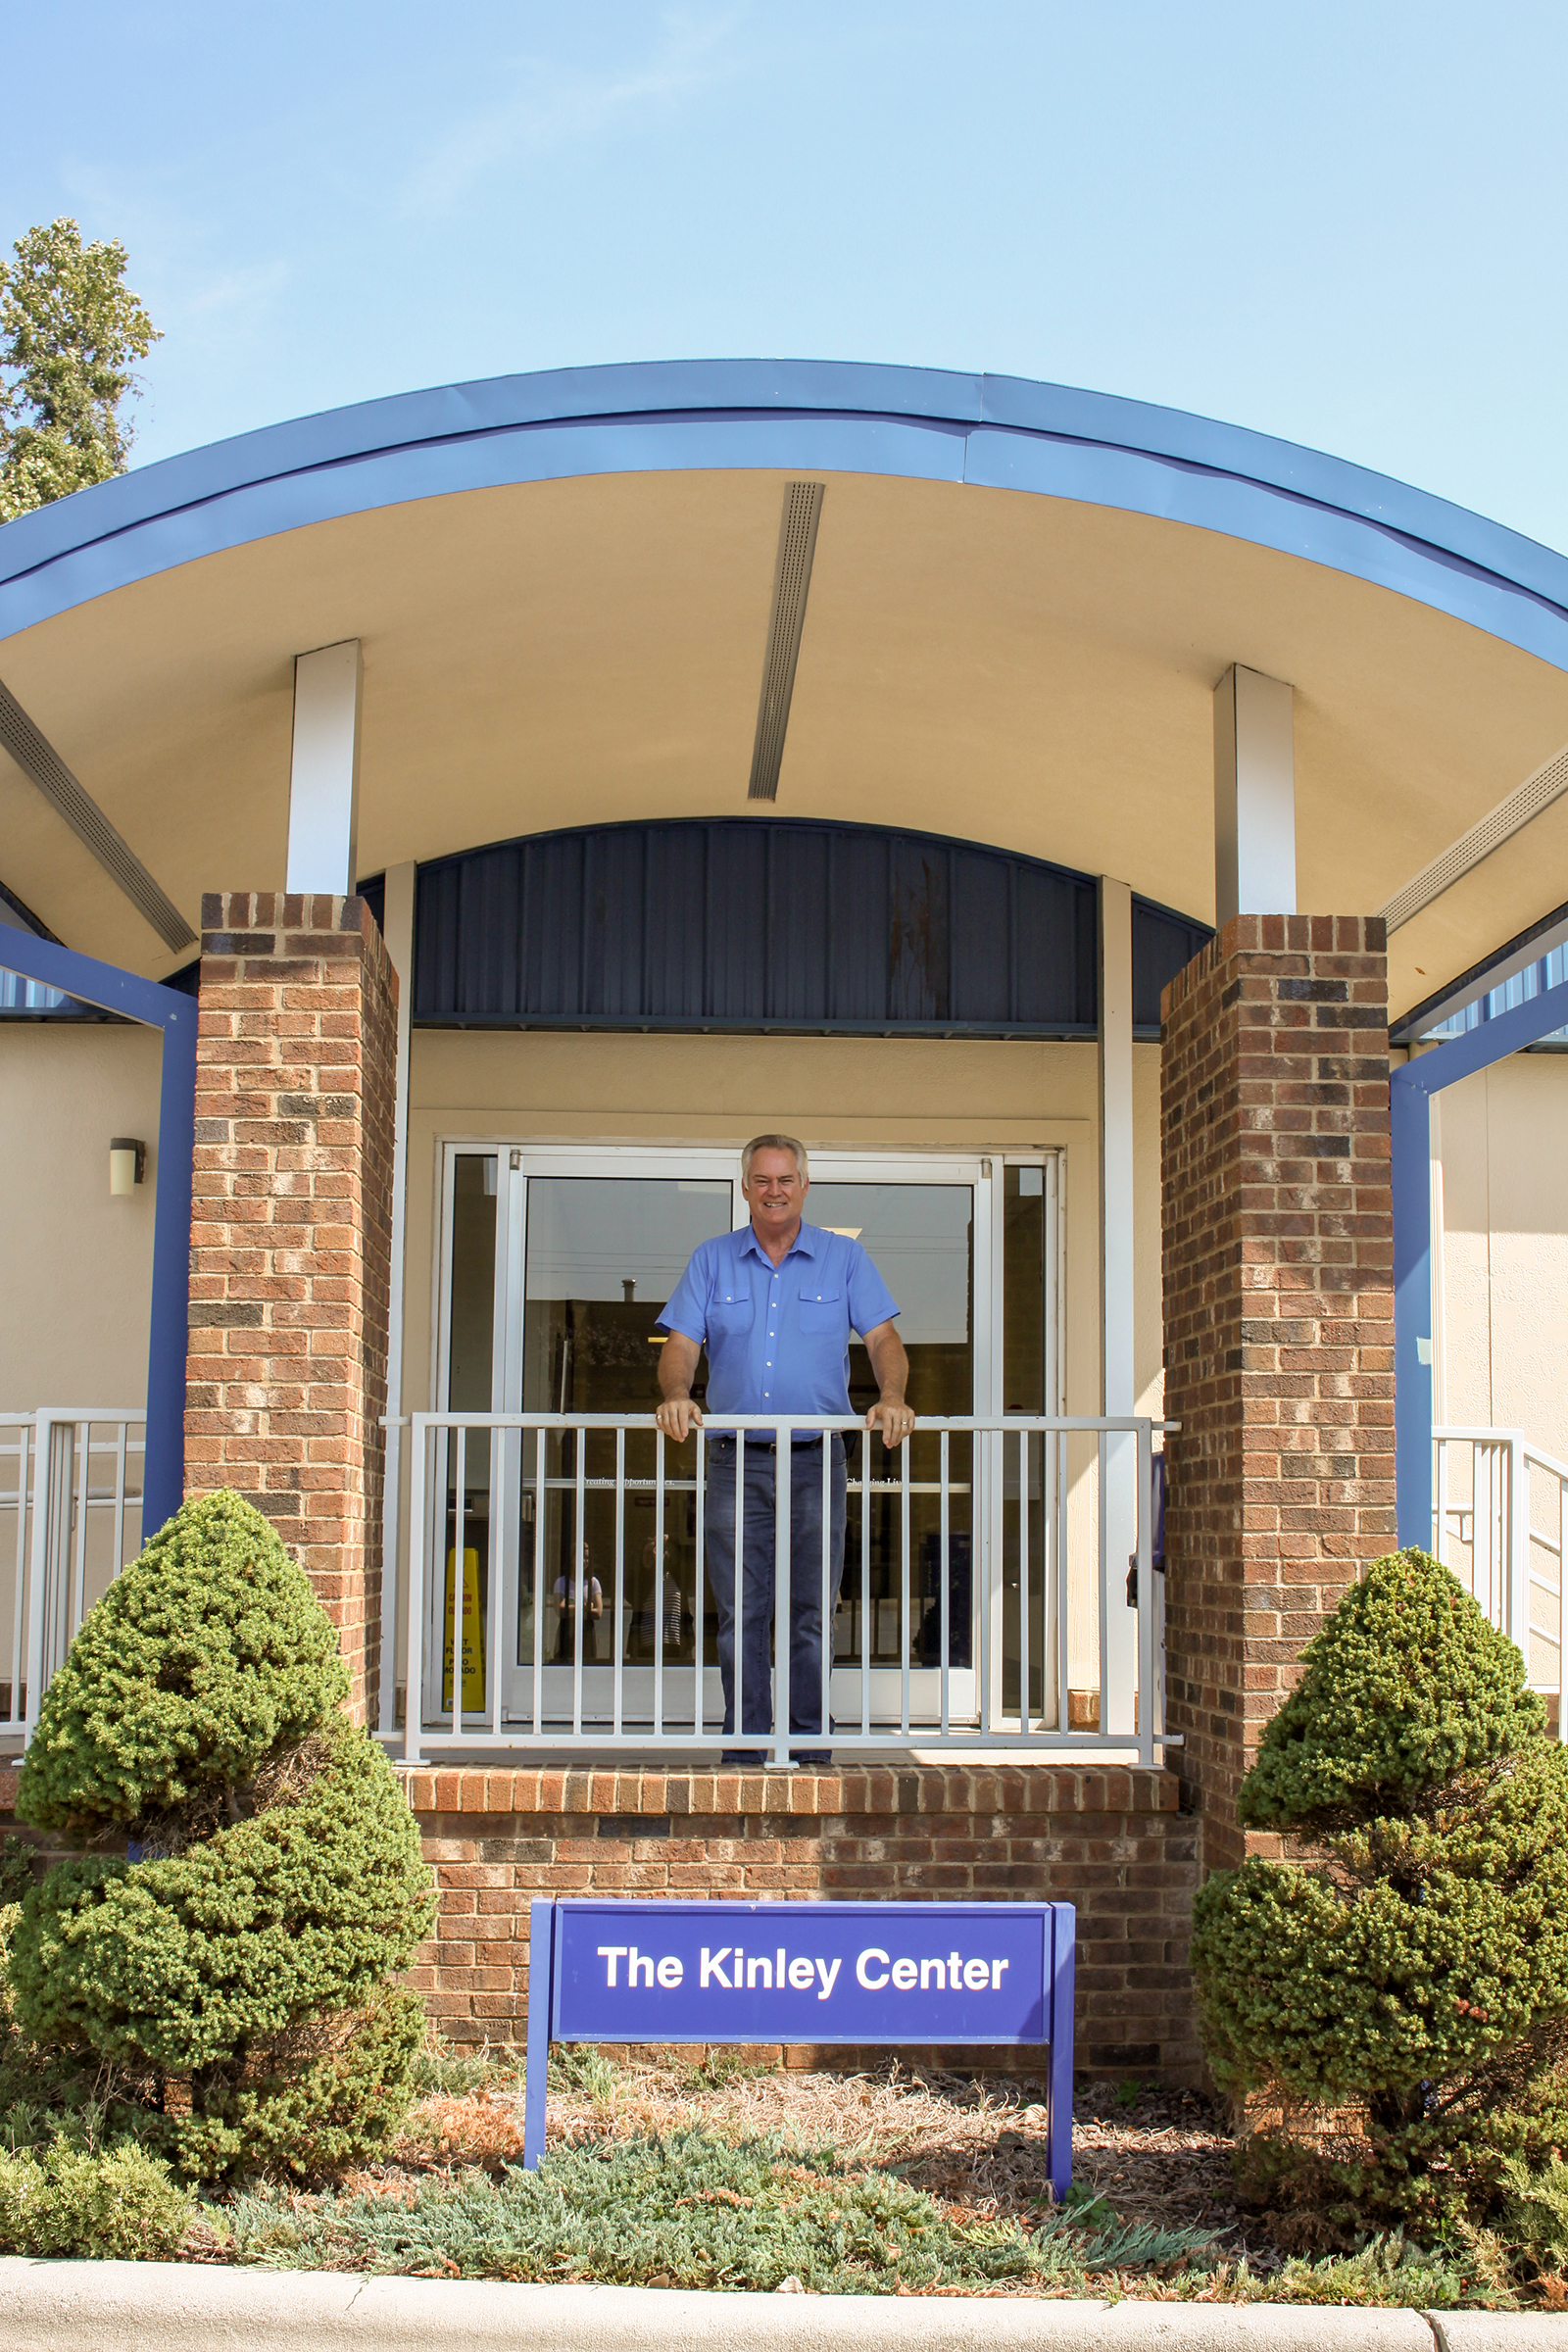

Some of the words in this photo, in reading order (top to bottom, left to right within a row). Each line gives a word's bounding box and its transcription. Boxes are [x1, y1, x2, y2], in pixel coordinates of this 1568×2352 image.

[581, 1477, 614, 1487] reating
[597, 1946, 684, 1988] The
[700, 1946, 842, 2000] Kinley
[856, 1947, 1009, 1990] Center
